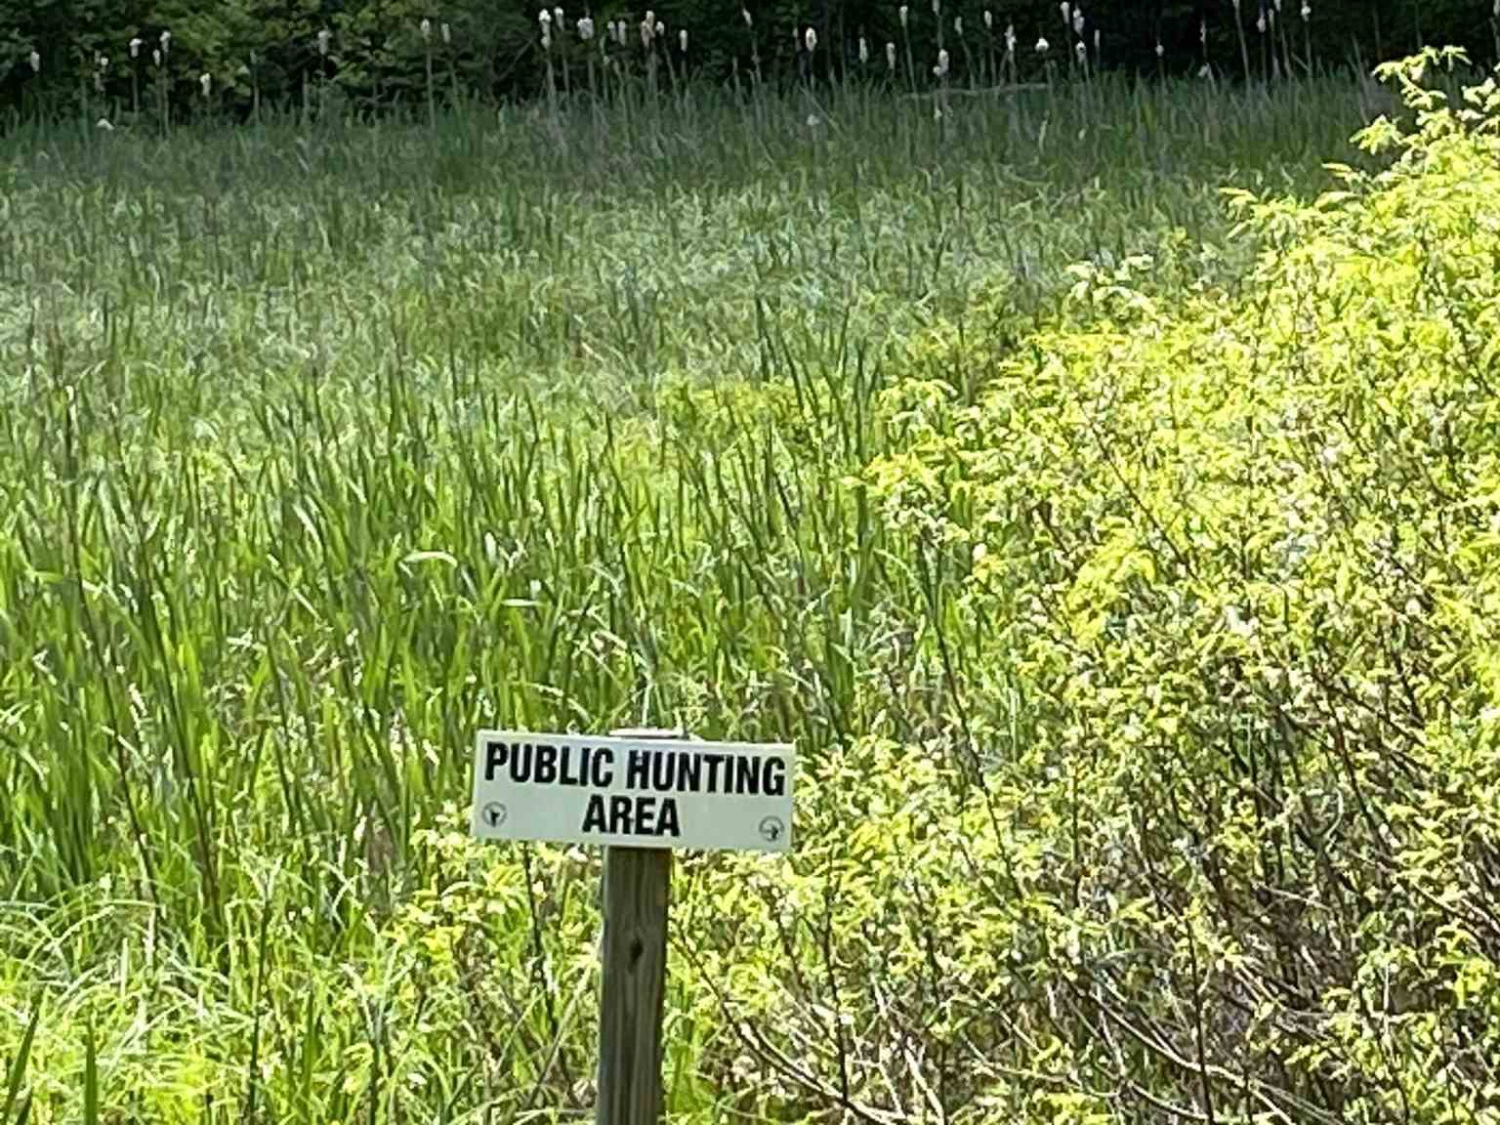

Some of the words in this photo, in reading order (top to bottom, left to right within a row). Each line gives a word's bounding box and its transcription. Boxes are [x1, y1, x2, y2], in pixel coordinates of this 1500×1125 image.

[484, 741, 615, 788] PUBLIC
[626, 749, 786, 797] HUNTING
[581, 793, 681, 838] AREA
